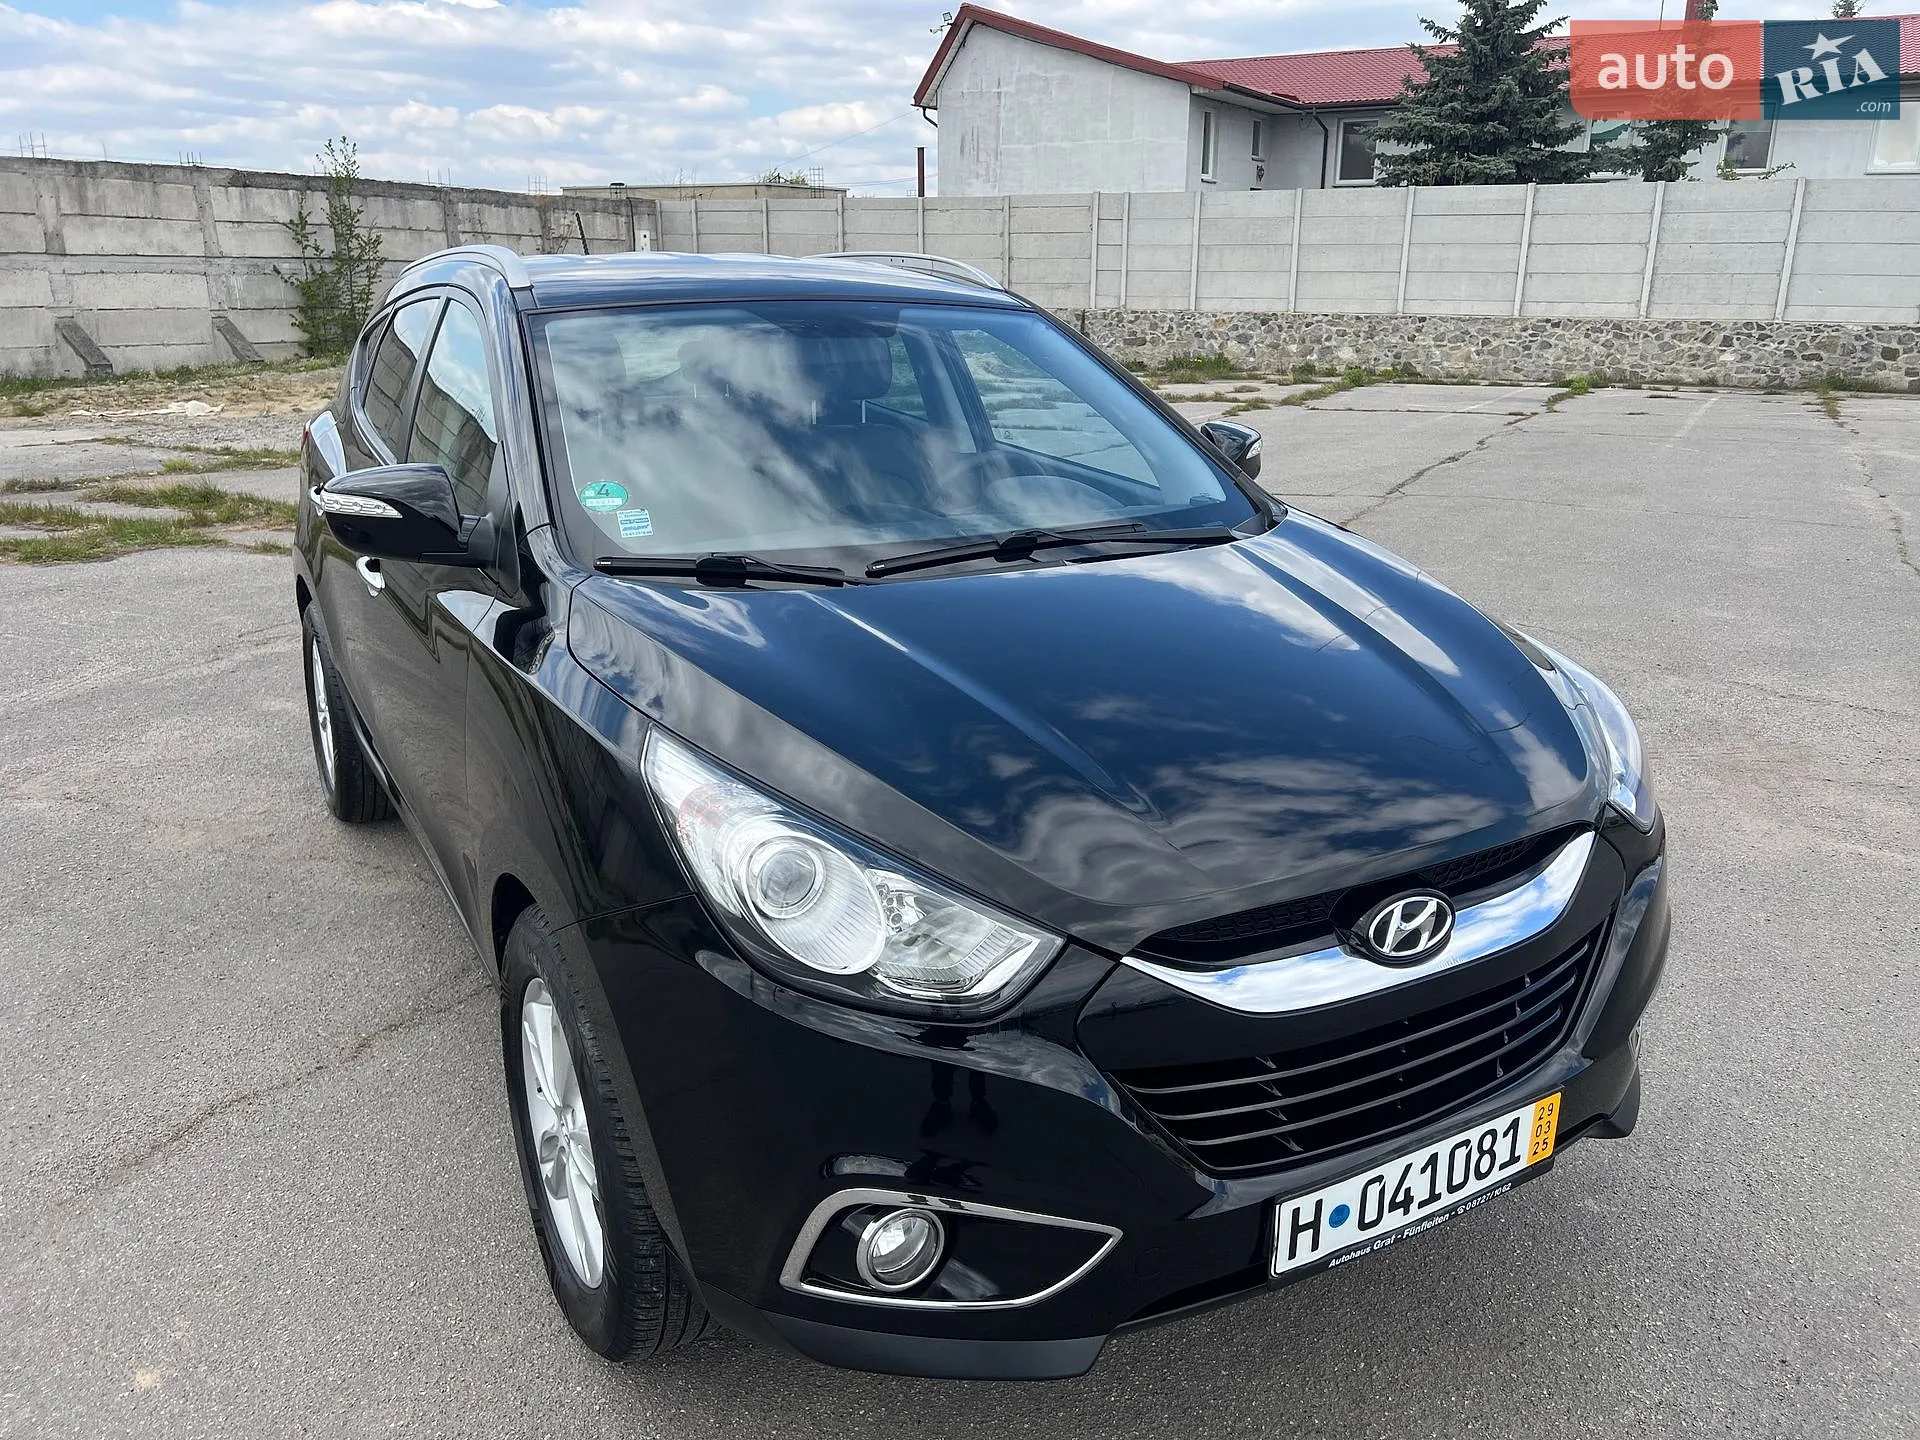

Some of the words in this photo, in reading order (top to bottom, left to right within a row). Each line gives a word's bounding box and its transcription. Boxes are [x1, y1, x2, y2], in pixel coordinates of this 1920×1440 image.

[597, 484, 610, 497] 4
[1538, 1103, 1554, 1121] 29
[1535, 1120, 1551, 1138] 03
[1532, 1137, 1549, 1156] 25
[1287, 1199, 1323, 1261] H
[1357, 1116, 1521, 1232] 041081
[1328, 1246, 1371, 1268] Autohaus
[1373, 1234, 1396, 1250] Graf
[1403, 1212, 1449, 1239] Fünfleiten
